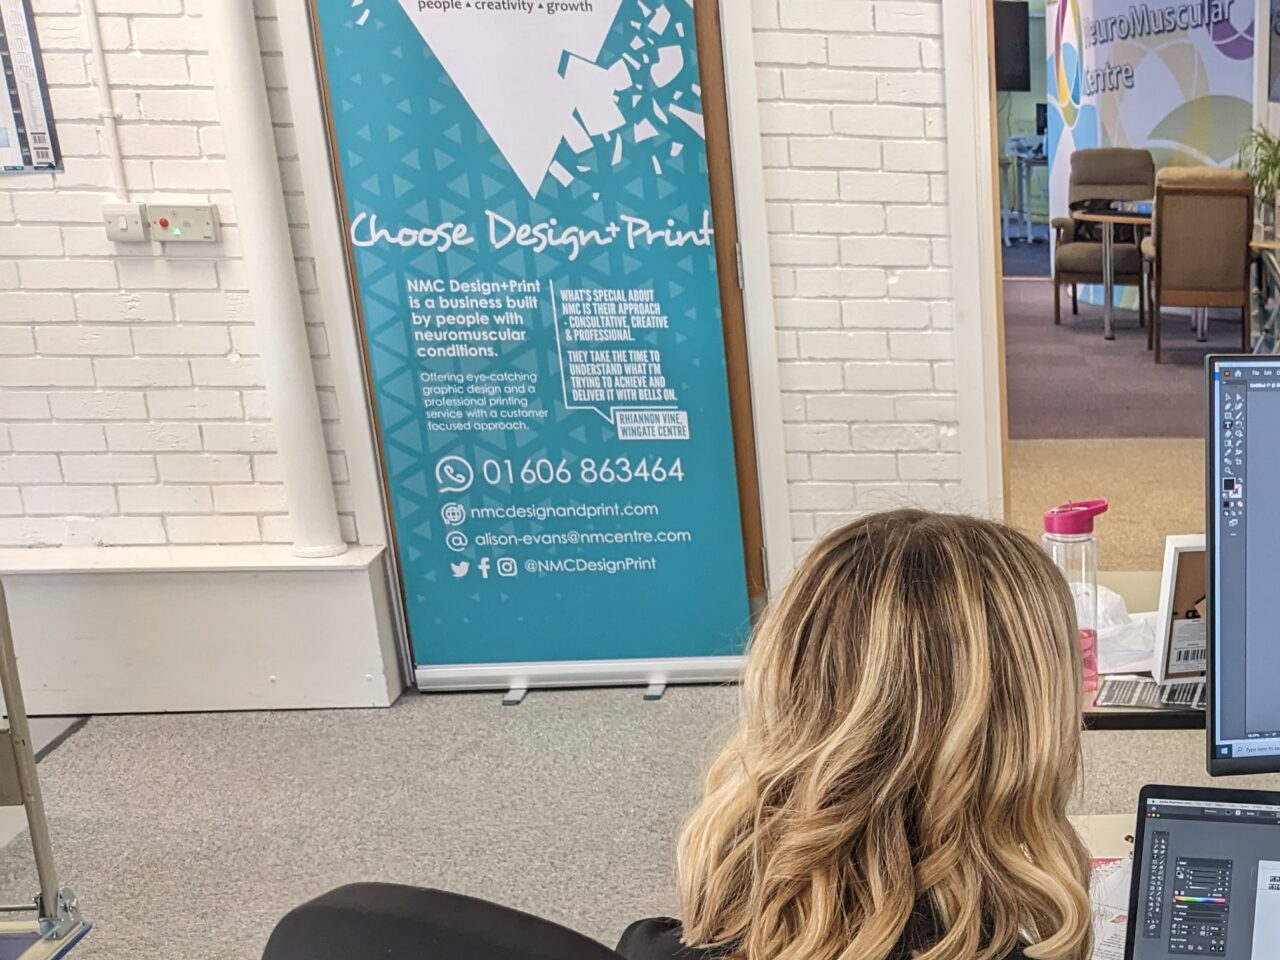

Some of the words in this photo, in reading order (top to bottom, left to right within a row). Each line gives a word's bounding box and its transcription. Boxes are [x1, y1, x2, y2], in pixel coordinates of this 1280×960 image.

[419, 0, 462, 12] people
[475, 0, 534, 13] creativity
[546, 2, 593, 15] growth
[350, 212, 474, 252] Choose
[407, 280, 445, 292] NMC
[449, 279, 540, 295] Design+Print
[560, 289, 592, 302] WHAT'S
[593, 289, 627, 302] SPECIAL
[628, 289, 654, 302] ABOUT
[409, 296, 421, 309] is
[424, 299, 435, 309] a
[440, 296, 502, 309] business
[506, 296, 538, 309] built
[562, 303, 581, 315] NMC
[582, 303, 592, 315] IS
[592, 303, 616, 315] THEIR
[618, 303, 661, 315] APPROACH
[412, 312, 431, 327] by
[436, 312, 489, 327] people
[493, 311, 524, 325] with
[569, 316, 630, 329] CONSULTATIVE,
[631, 316, 669, 328] CREATIVE
[414, 328, 526, 341] neuromuscular
[565, 329, 573, 341] &
[574, 329, 636, 341] PROFESSIONAL.
[417, 344, 498, 357] conditions.
[567, 350, 588, 362] THEY
[589, 350, 611, 362] TAKE
[612, 350, 627, 362] THE
[628, 350, 649, 362] TIME
[649, 350, 660, 362] TO
[569, 363, 622, 375] UNDERSTAND
[624, 363, 646, 375] WHAT
[648, 363, 661, 375] I'M
[420, 372, 464, 383] Offering
[466, 371, 537, 383] eye-catching
[570, 376, 600, 388] TRYING
[602, 376, 613, 388] TO
[614, 376, 647, 388] ACHIEVE
[649, 376, 666, 388] AND
[422, 384, 464, 396] graphic
[466, 384, 501, 396] design
[504, 384, 525, 393] and
[572, 389, 605, 401] DELIVER
[606, 389, 614, 401] IT
[616, 389, 637, 401] WITH
[638, 388, 662, 401] BELLS
[663, 388, 677, 401] ON.
[424, 397, 486, 408] professional
[489, 397, 528, 408] printing
[426, 410, 463, 419] service
[466, 409, 487, 418] with
[490, 410, 498, 418] a
[500, 408, 548, 418] customer
[619, 413, 660, 424] RHIANNON
[428, 421, 471, 431] focused
[473, 421, 529, 432] approach.
[620, 426, 656, 437] WINGATE
[658, 425, 687, 437] CENTRE
[483, 459, 572, 485] 01606
[580, 457, 685, 483] 863464
[471, 502, 659, 519] nmcdesignandprint.com
[475, 530, 691, 546] alison-evans@nmcentre.com
[525, 557, 657, 573] @NMCDesignPrint
